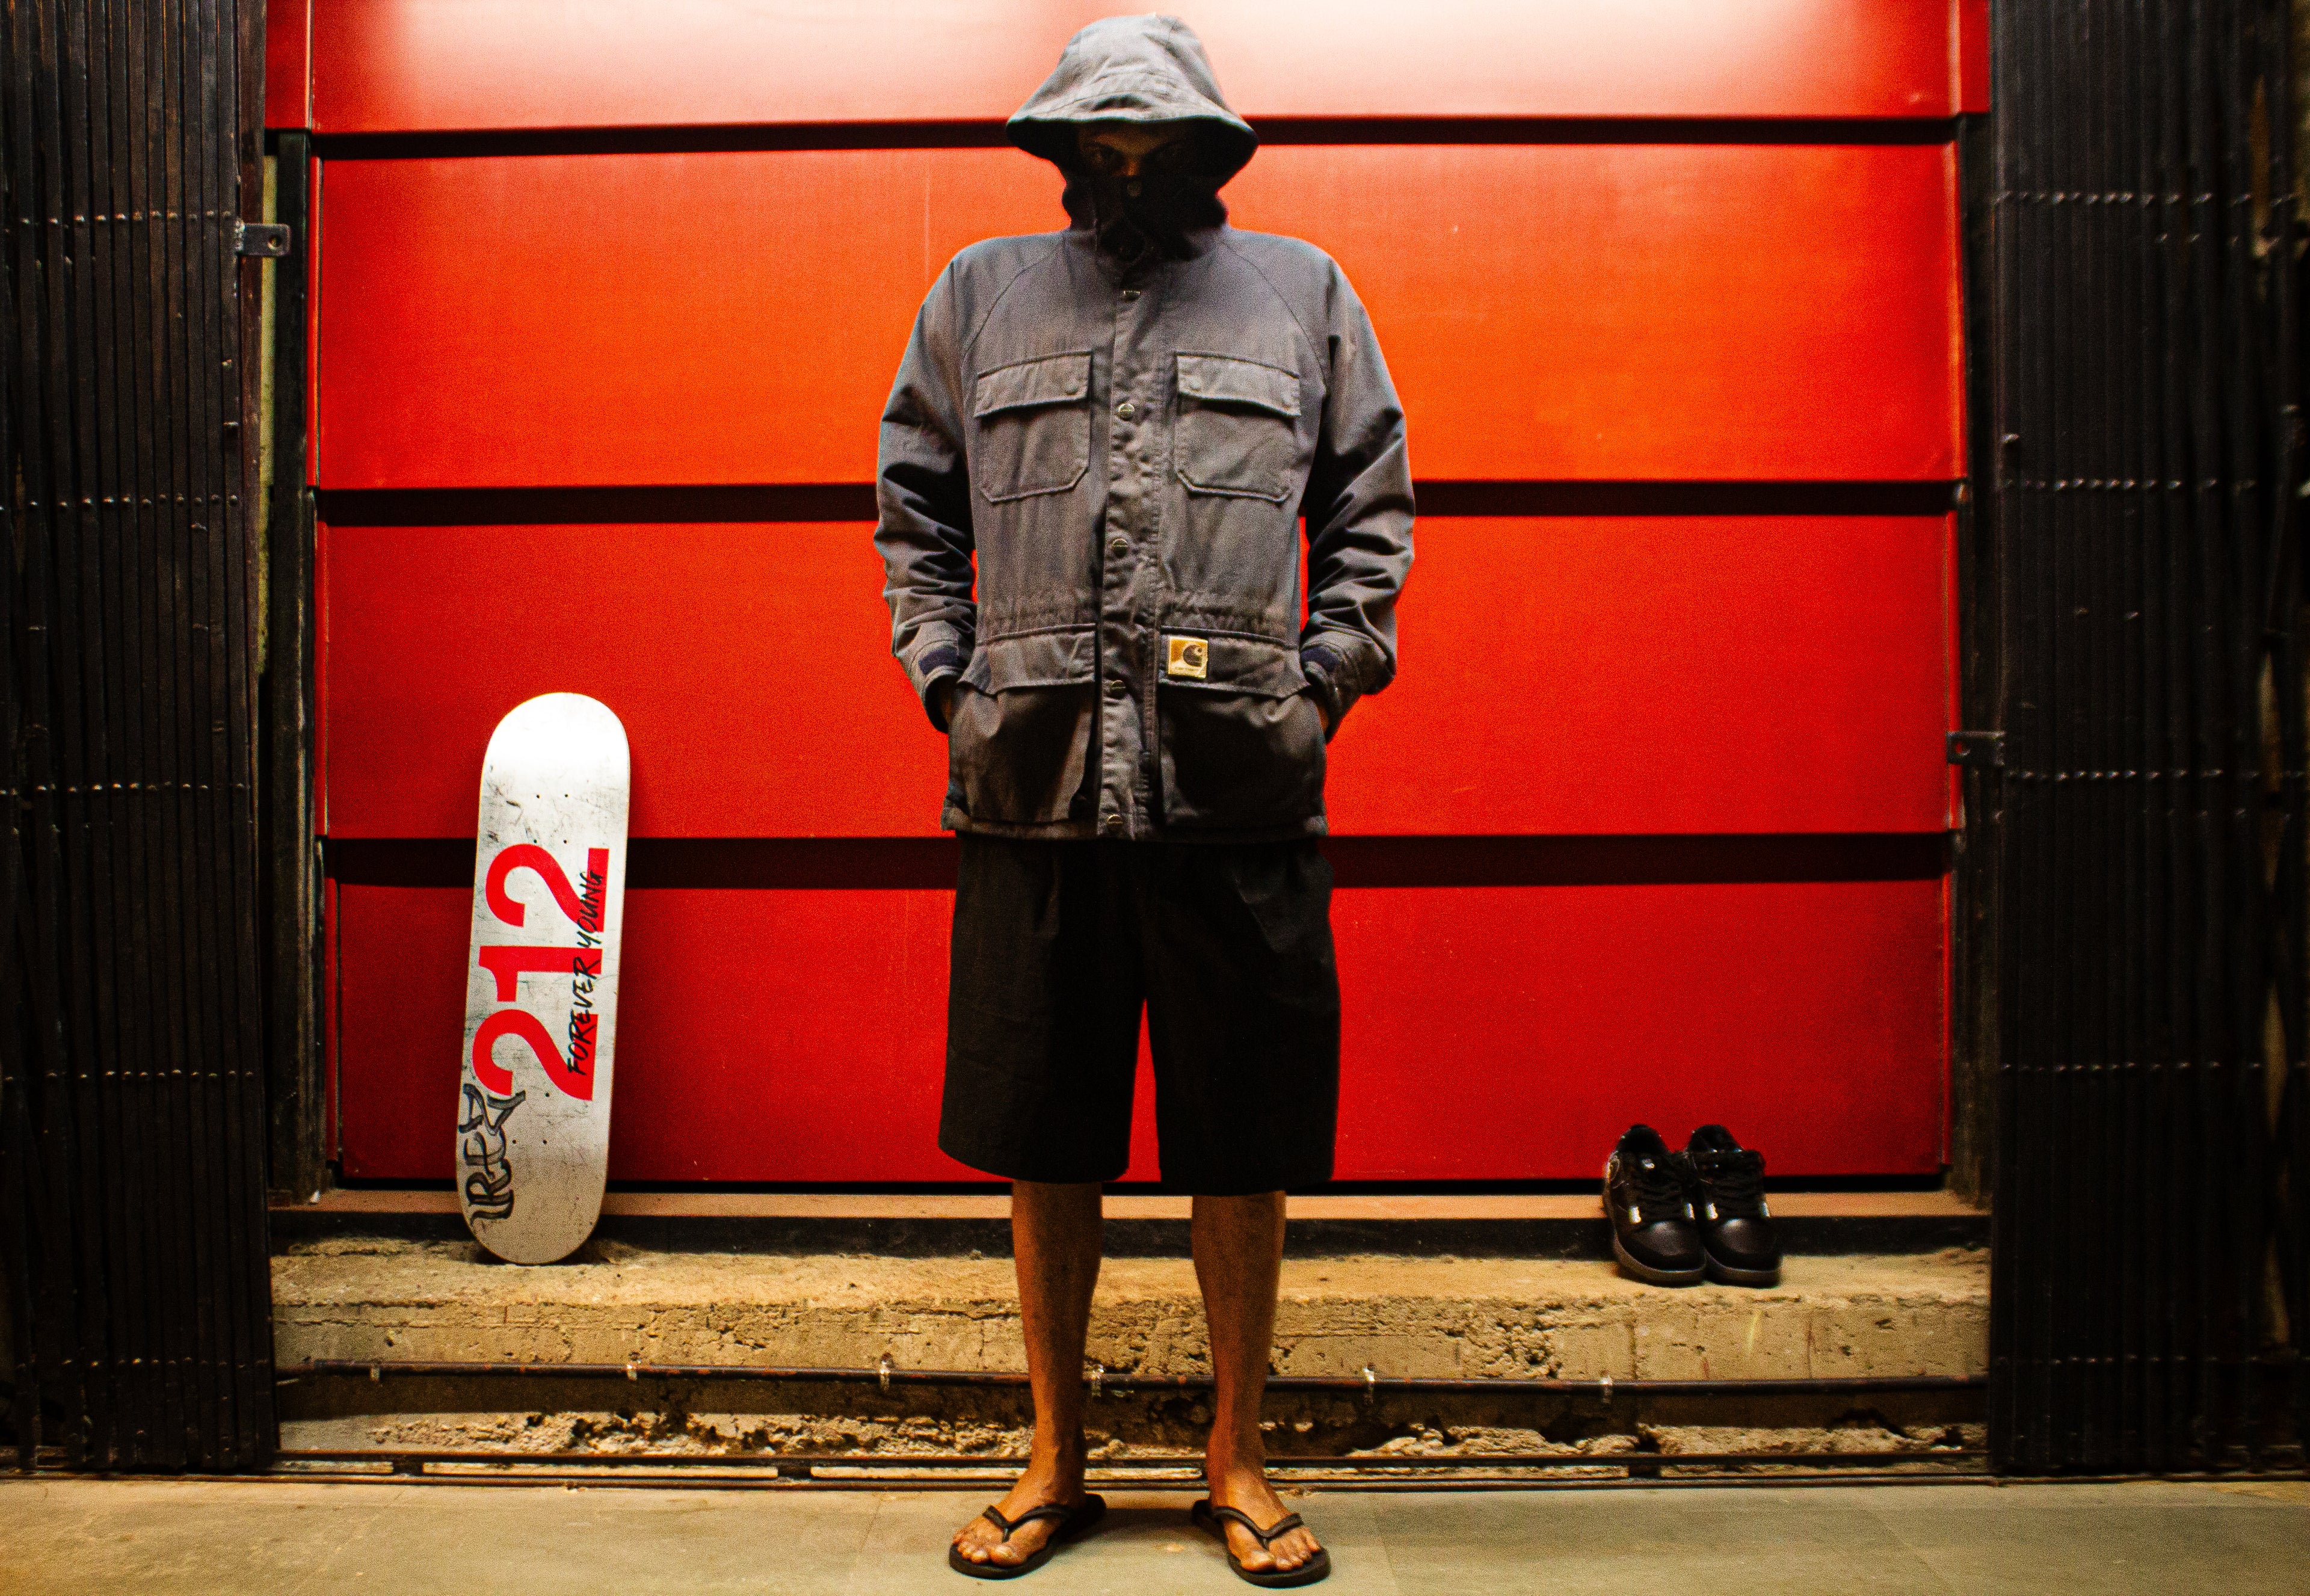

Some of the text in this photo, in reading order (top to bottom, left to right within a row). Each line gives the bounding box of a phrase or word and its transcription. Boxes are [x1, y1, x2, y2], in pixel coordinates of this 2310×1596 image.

[472, 843, 609, 1101] 212
[567, 870, 603, 1076] FOREVER YOUNG
